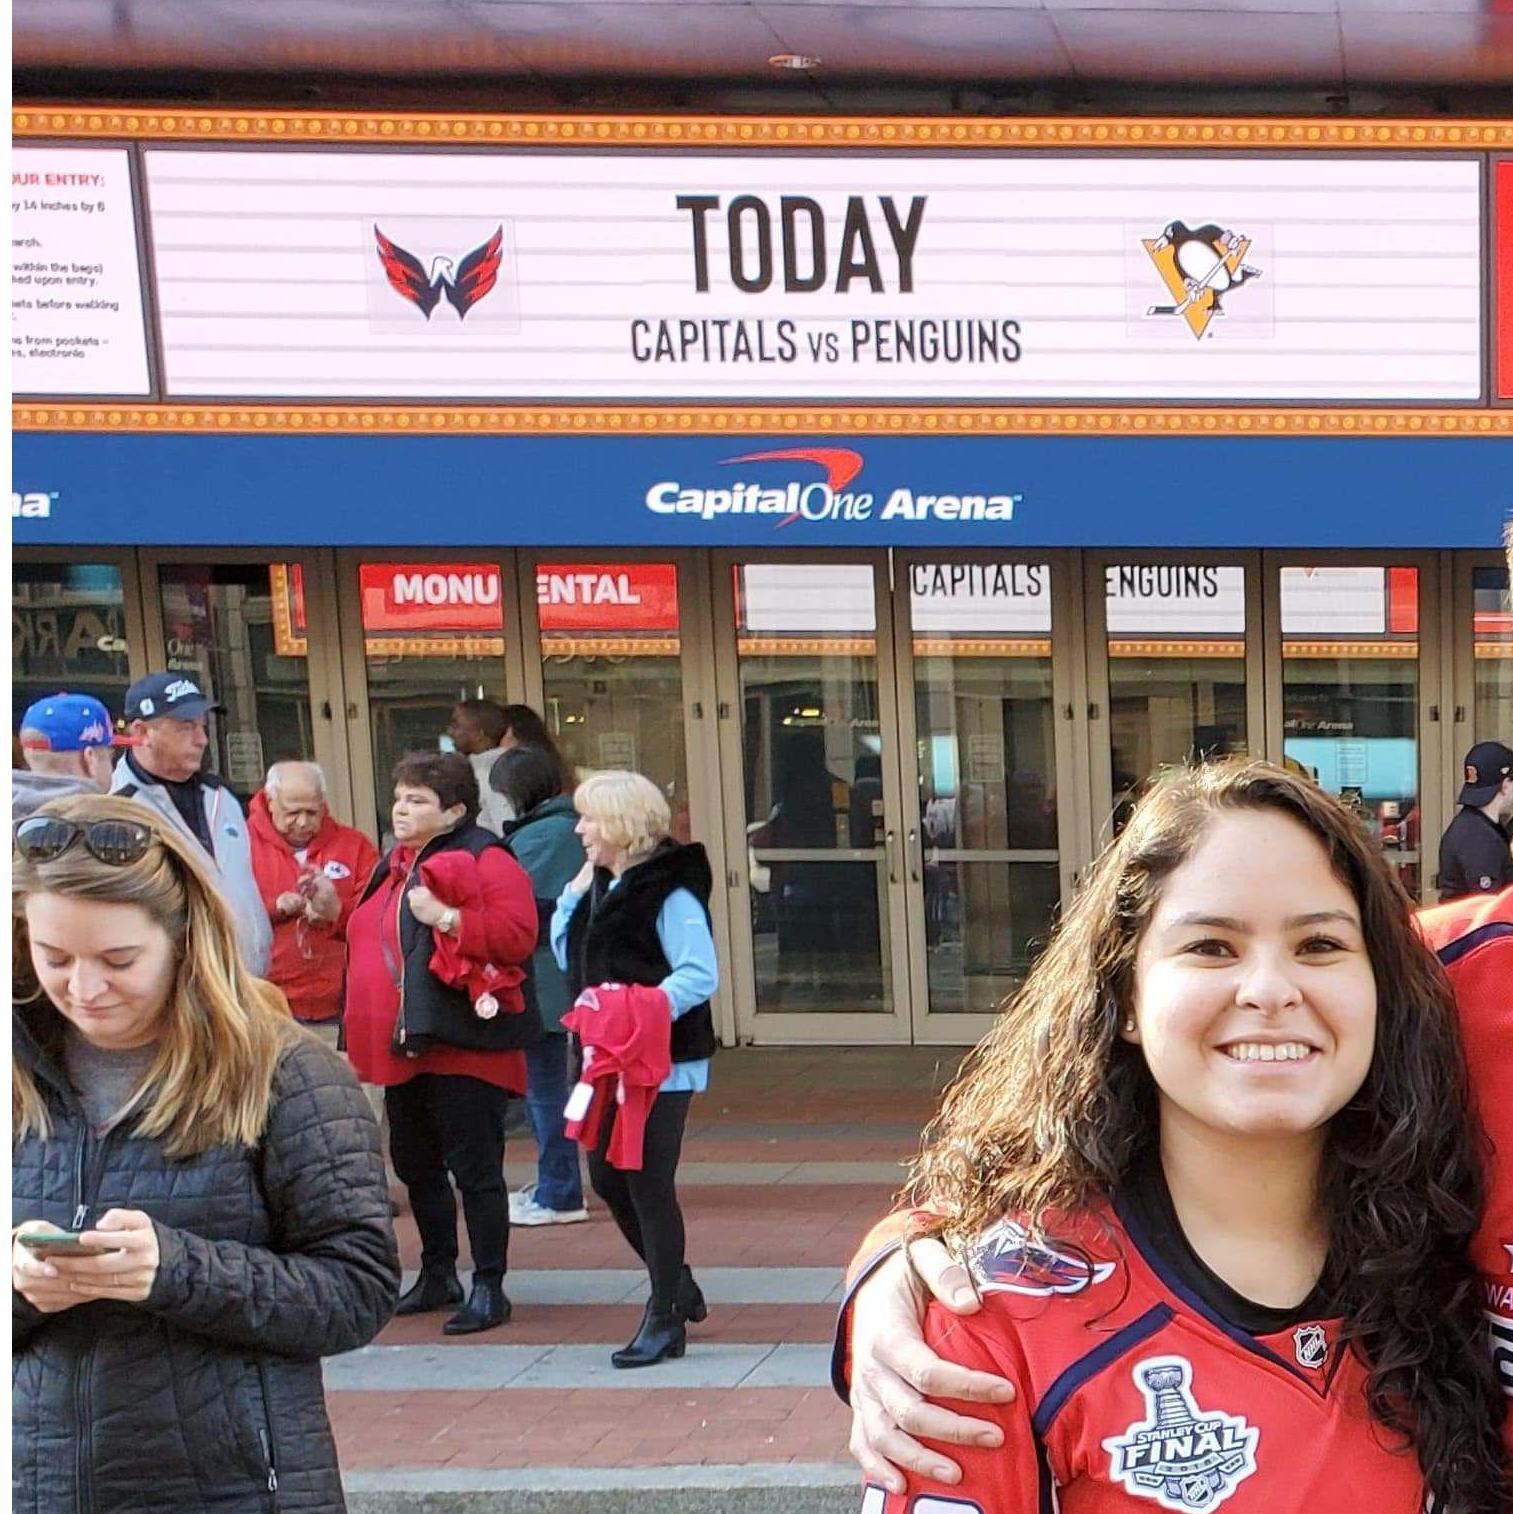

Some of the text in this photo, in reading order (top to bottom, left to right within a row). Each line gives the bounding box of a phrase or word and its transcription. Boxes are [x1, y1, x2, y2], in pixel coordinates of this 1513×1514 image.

[41, 199, 78, 212] inches
[81, 200, 95, 213] by
[676, 195, 928, 294] TODAY
[34, 276, 63, 287] upon
[51, 263, 69, 273] the
[36, 299, 72, 309] before
[75, 300, 119, 311] walking
[25, 335, 52, 346] from
[55, 335, 100, 348] pockets
[631, 319, 797, 364] CAPITALS
[851, 319, 1022, 364] PENGUINS
[881, 489, 1015, 520] Arena
[392, 573, 499, 605] MONU
[912, 564, 1042, 597] CAPITALS
[1137, 1420, 1223, 1445] STANLEY CUP
[1124, 1428, 1247, 1469] FINAL
